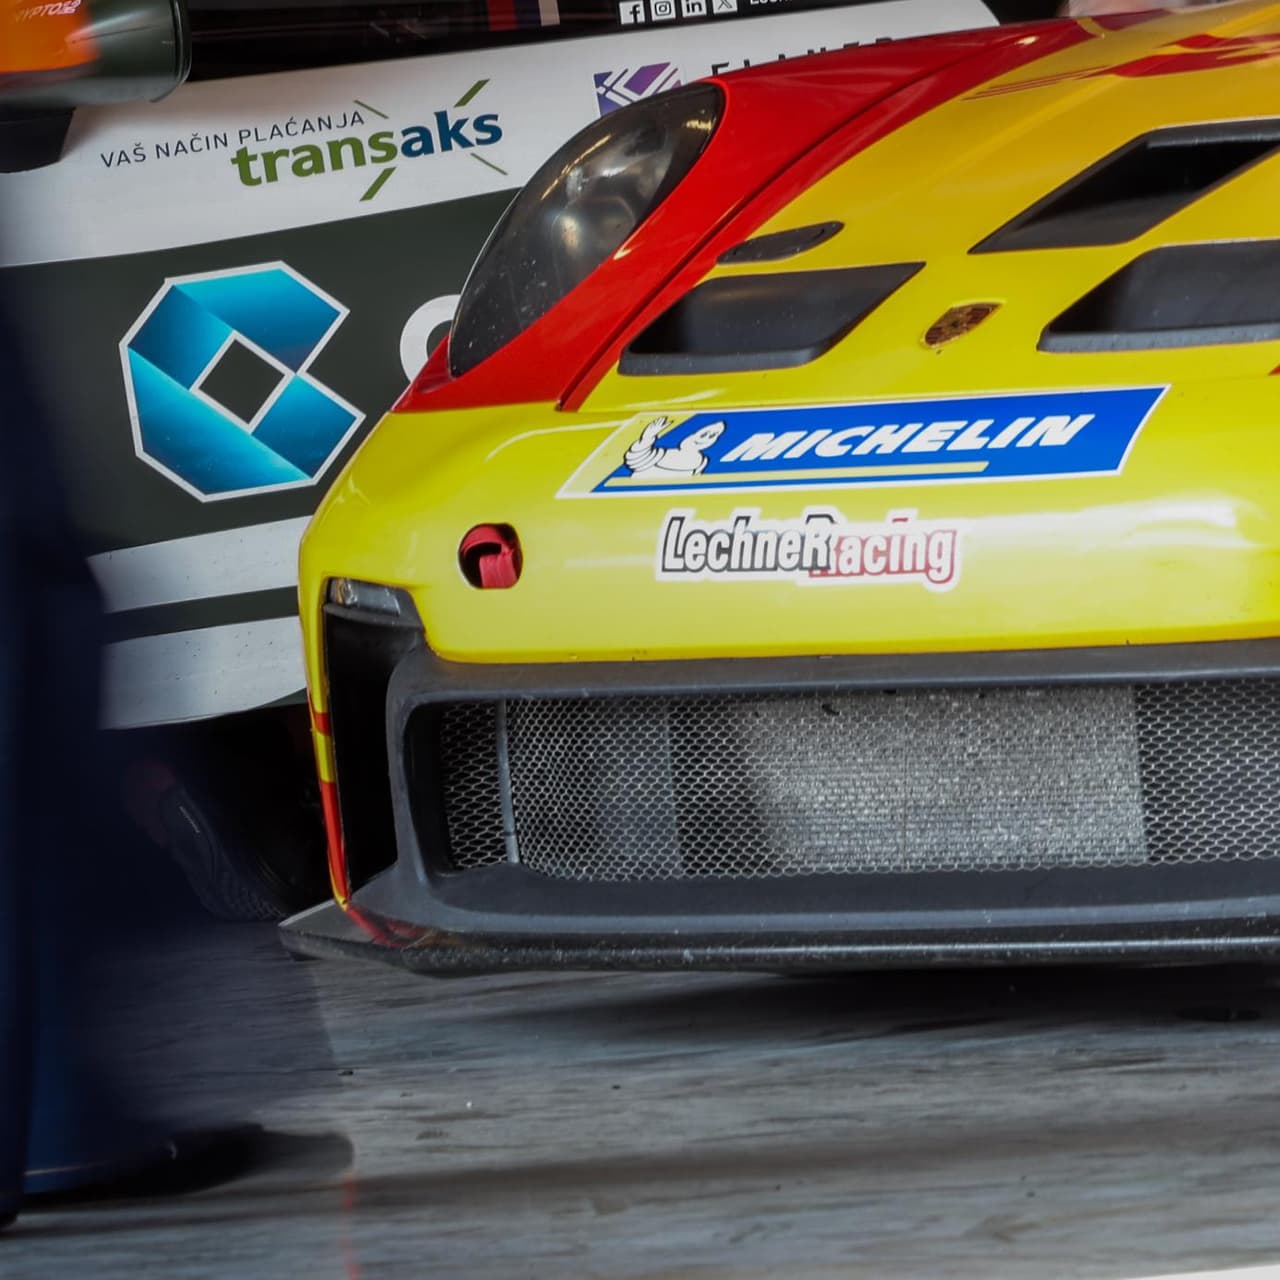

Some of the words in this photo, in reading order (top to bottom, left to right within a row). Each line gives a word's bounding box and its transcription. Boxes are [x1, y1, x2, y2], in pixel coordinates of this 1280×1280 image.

[101, 141, 146, 169] VAŠ
[155, 130, 229, 159] NAČIN
[239, 110, 365, 145] PLAĆANJA
[231, 110, 503, 187] transaks
[720, 413, 1097, 464] MICHELIN
